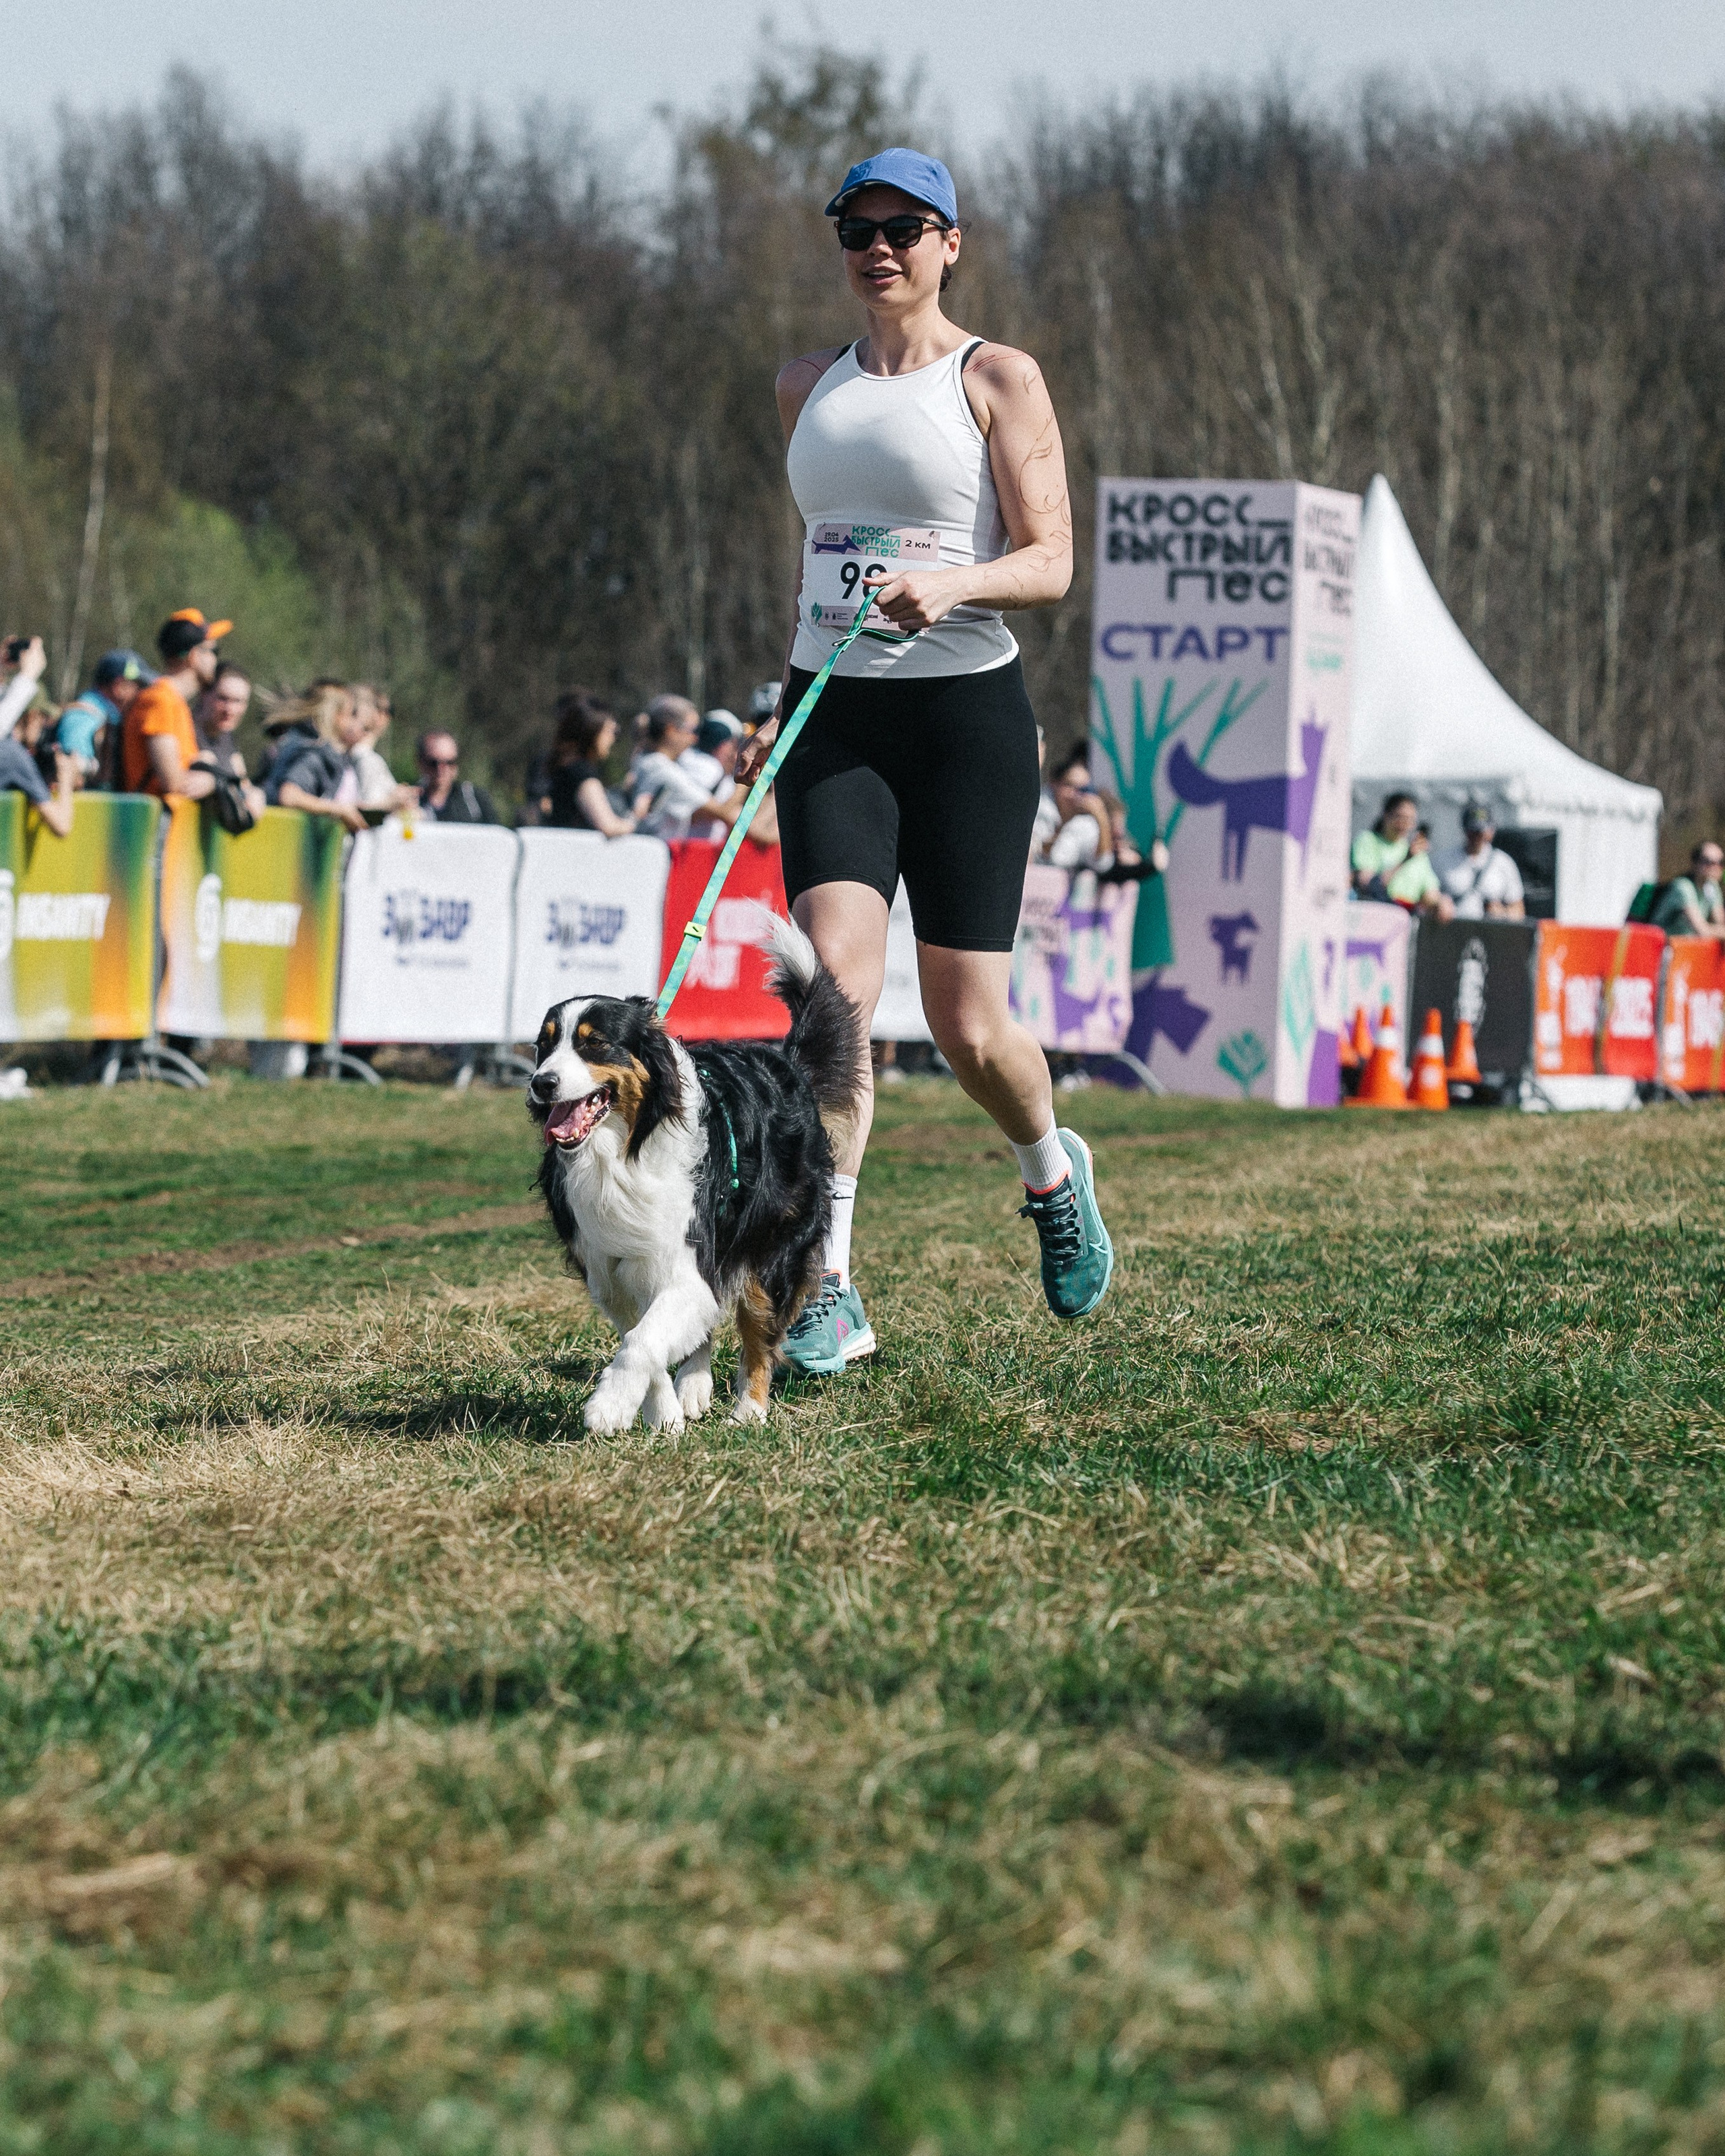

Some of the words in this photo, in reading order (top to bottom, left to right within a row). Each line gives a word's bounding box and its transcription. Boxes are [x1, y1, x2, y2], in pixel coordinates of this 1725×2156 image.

[1108, 493, 1252, 528] КРОСС
[852, 526, 891, 537] КРОСС
[905, 540, 912, 548] 2
[1100, 623, 1288, 662] СТАРТ
